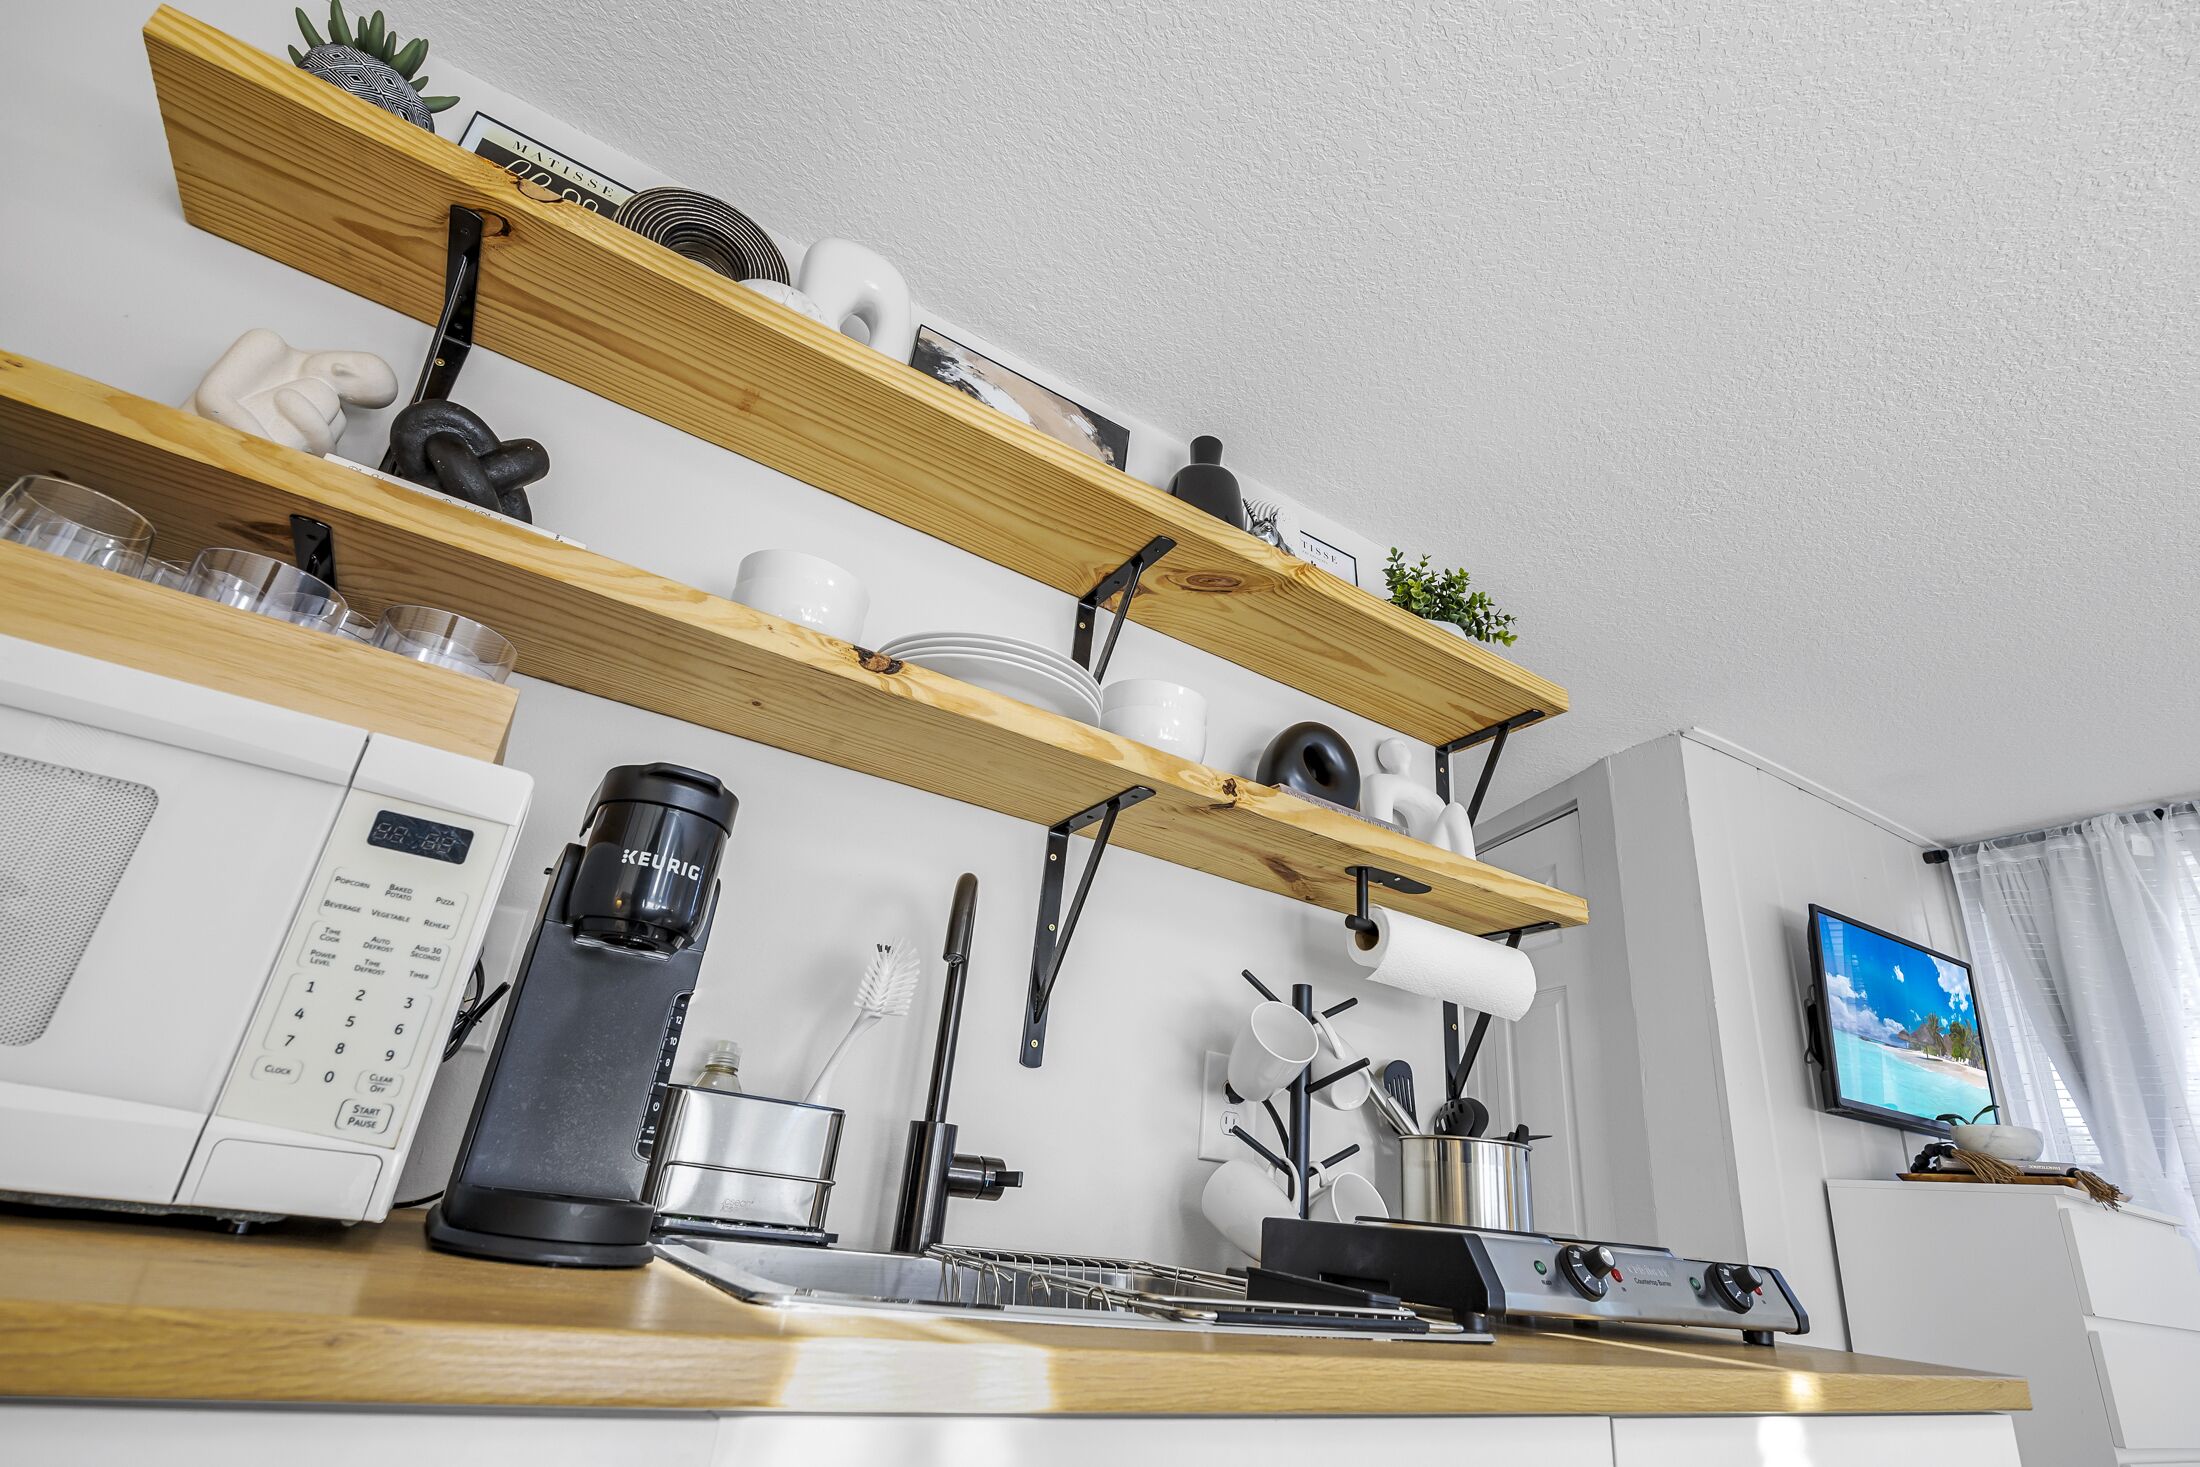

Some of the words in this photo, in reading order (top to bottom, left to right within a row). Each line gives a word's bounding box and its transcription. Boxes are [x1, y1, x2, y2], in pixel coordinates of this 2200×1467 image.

[512, 140, 615, 198] MATISSE
[621, 849, 701, 881] KEURIG
[334, 876, 371, 889] POPCORN
[389, 884, 413, 894] BAKED
[385, 890, 412, 901] POTATO
[324, 900, 361, 913] BEVERAGE
[435, 897, 455, 906] PIZZA
[371, 909, 411, 923] VEGETABLE
[424, 919, 450, 930] REHEAT
[325, 927, 341, 936] TIME
[319, 934, 340, 943] COOK
[371, 936, 391, 946] AUTO
[363, 942, 394, 953] DEFROST
[415, 945, 430, 953] ADD
[431, 947, 442, 955] 30
[310, 949, 336, 960] POWER
[410, 951, 441, 962] SECONDS
[310, 957, 330, 967] LEVEL
[364, 959, 381, 968] TIME
[354, 965, 385, 976] DEFROST
[409, 971, 429, 980] TIMER
[306, 981, 315, 993] 1
[355, 989, 366, 1001] 2
[403, 997, 414, 1009] 3
[294, 1008, 304, 1020] 4
[345, 1016, 356, 1027] 5
[675, 1016, 683, 1025] 12
[394, 1023, 405, 1035] 6
[284, 1035, 295, 1047] 7
[669, 1036, 678, 1046] 10
[334, 1042, 345, 1054] 8
[384, 1050, 395, 1062] 9
[665, 1058, 671, 1067] 8
[264, 1064, 292, 1075] CLOCK
[324, 1071, 335, 1083] 0
[369, 1073, 394, 1083] CLEAR
[369, 1085, 386, 1093] OFF
[352, 1104, 381, 1116] START
[347, 1117, 377, 1129] PAUSE
